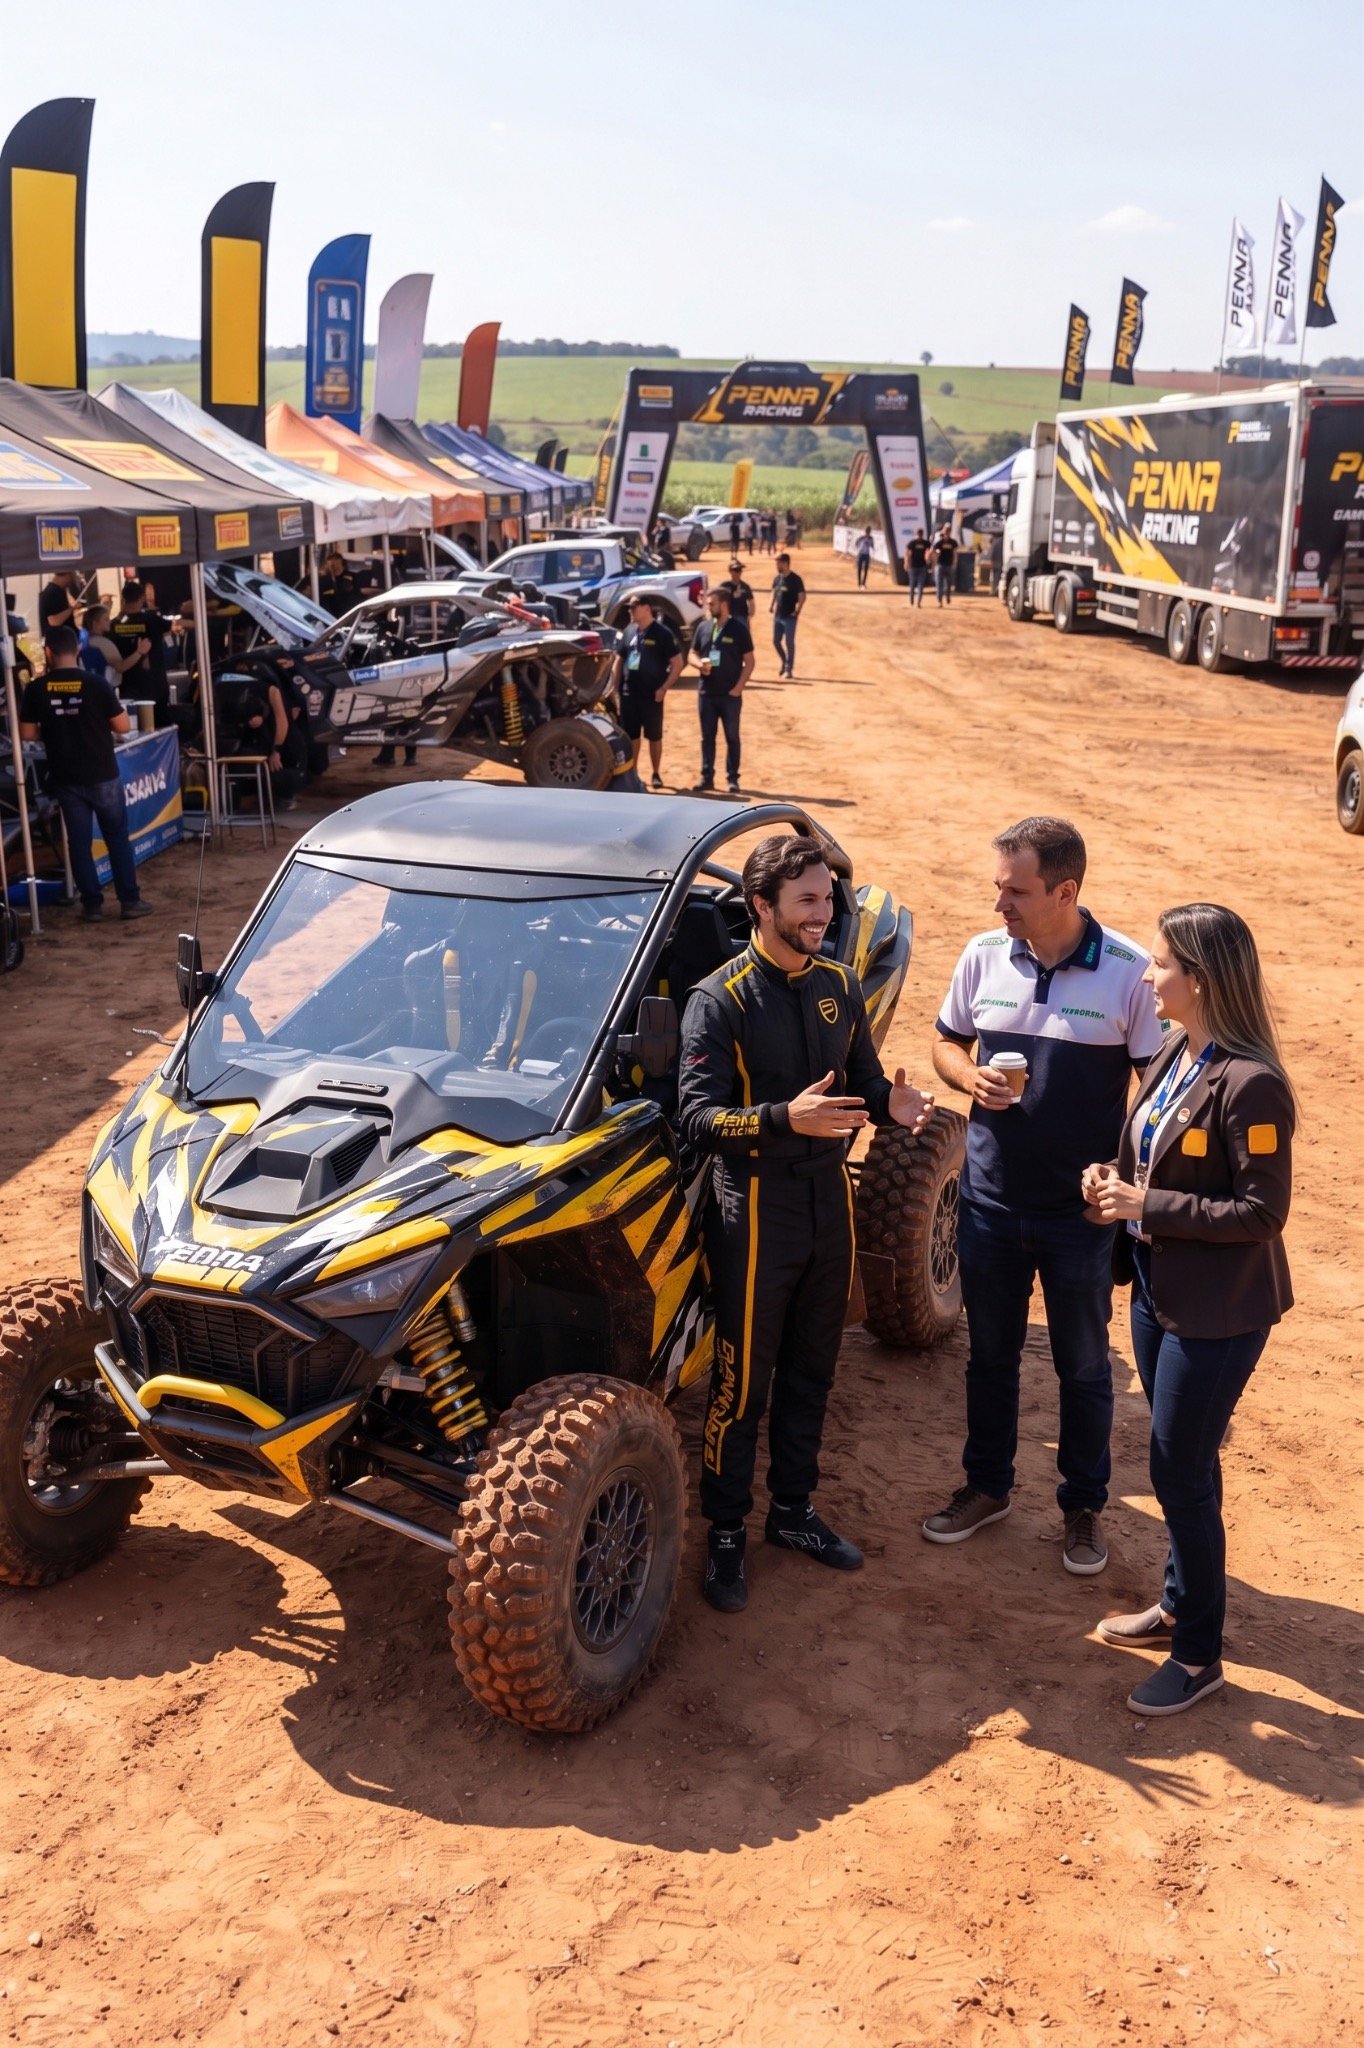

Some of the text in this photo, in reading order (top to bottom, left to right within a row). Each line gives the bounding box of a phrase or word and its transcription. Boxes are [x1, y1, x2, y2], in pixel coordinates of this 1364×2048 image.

[1231, 238, 1247, 327] PENNA
[1274, 222, 1291, 319] PENNA
[1313, 201, 1335, 307] PENNA
[1064, 315, 1086, 386] PENNA
[1115, 293, 1138, 369] PENNA
[727, 385, 821, 406] PENNA
[742, 405, 804, 417] RACING
[1127, 460, 1221, 513] PENNA
[1141, 512, 1200, 545] RACING
[721, 1126, 759, 1136] RACING
